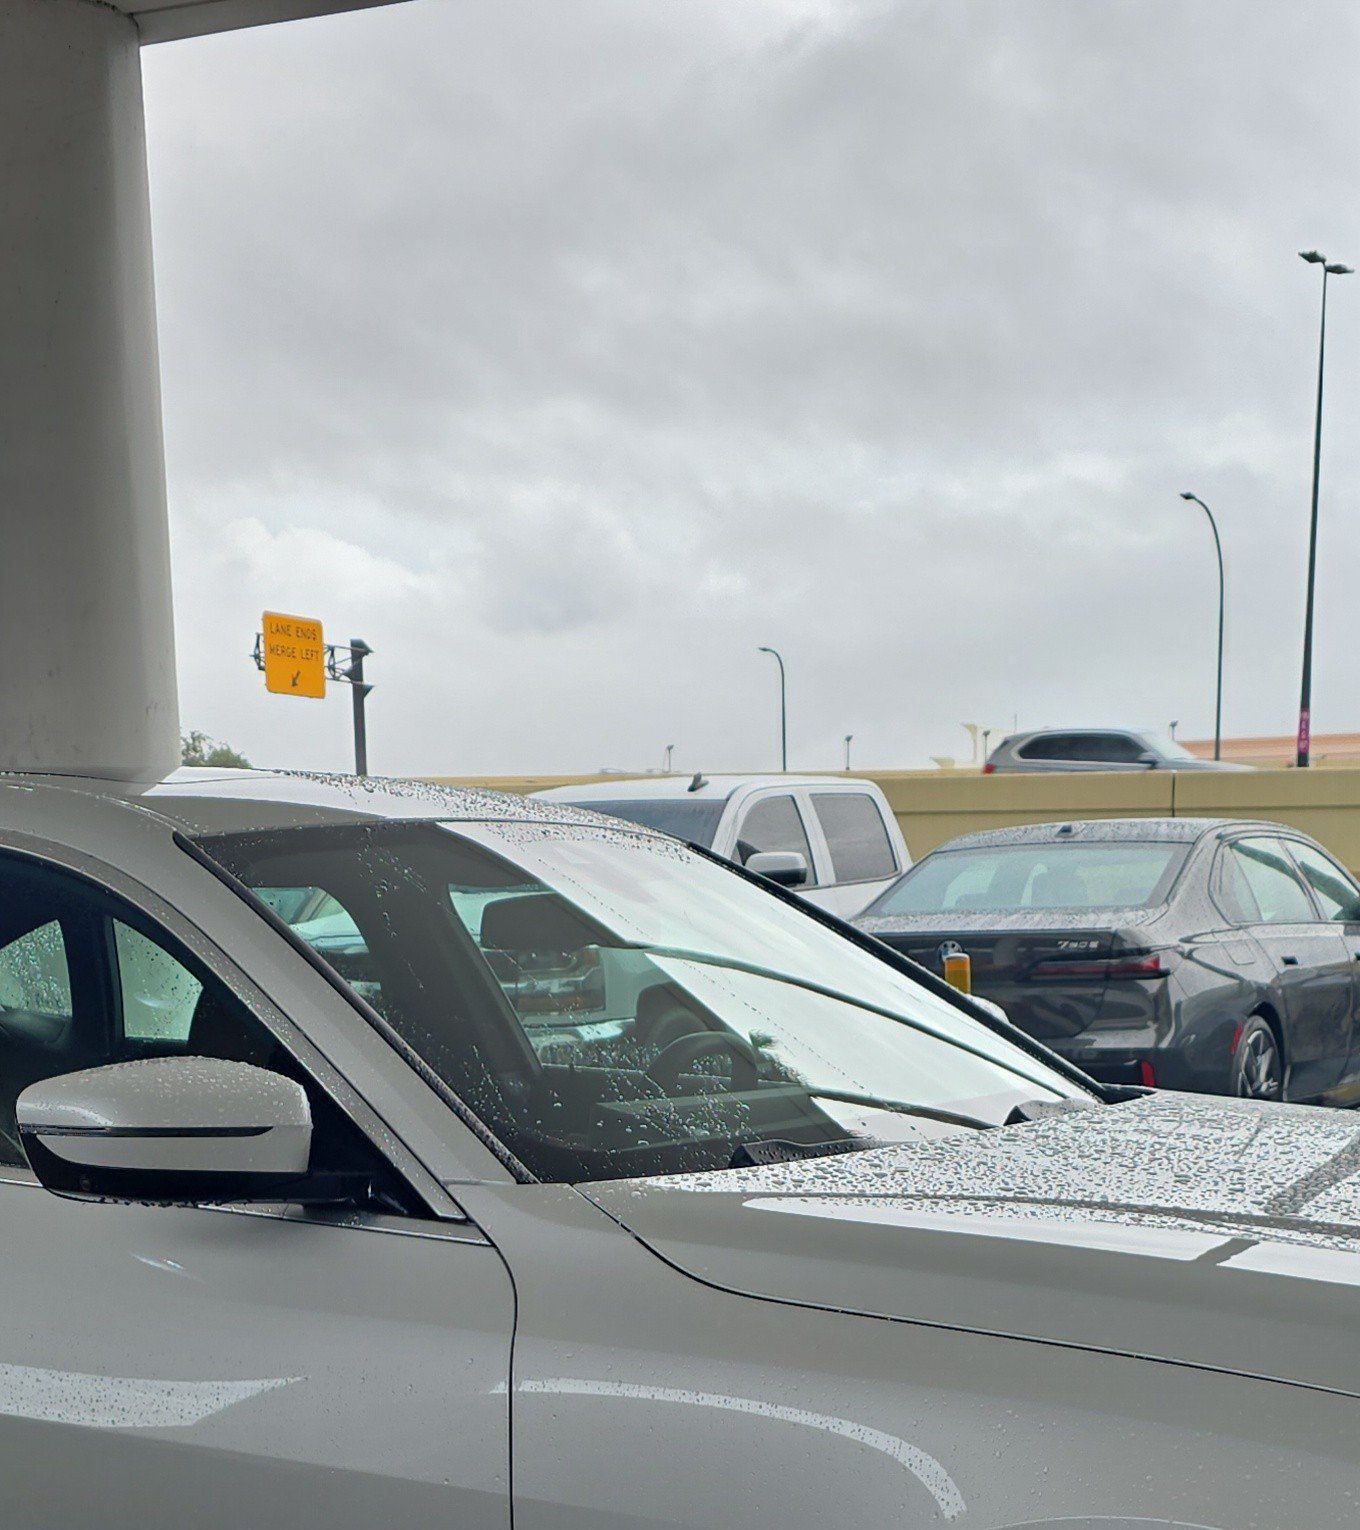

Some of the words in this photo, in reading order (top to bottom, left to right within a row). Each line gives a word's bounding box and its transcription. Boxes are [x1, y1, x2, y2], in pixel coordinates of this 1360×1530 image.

[270, 624, 292, 638] LANE
[296, 627, 317, 641] ENDS
[269, 645, 296, 659] MERGE
[301, 648, 320, 661] LEFT
